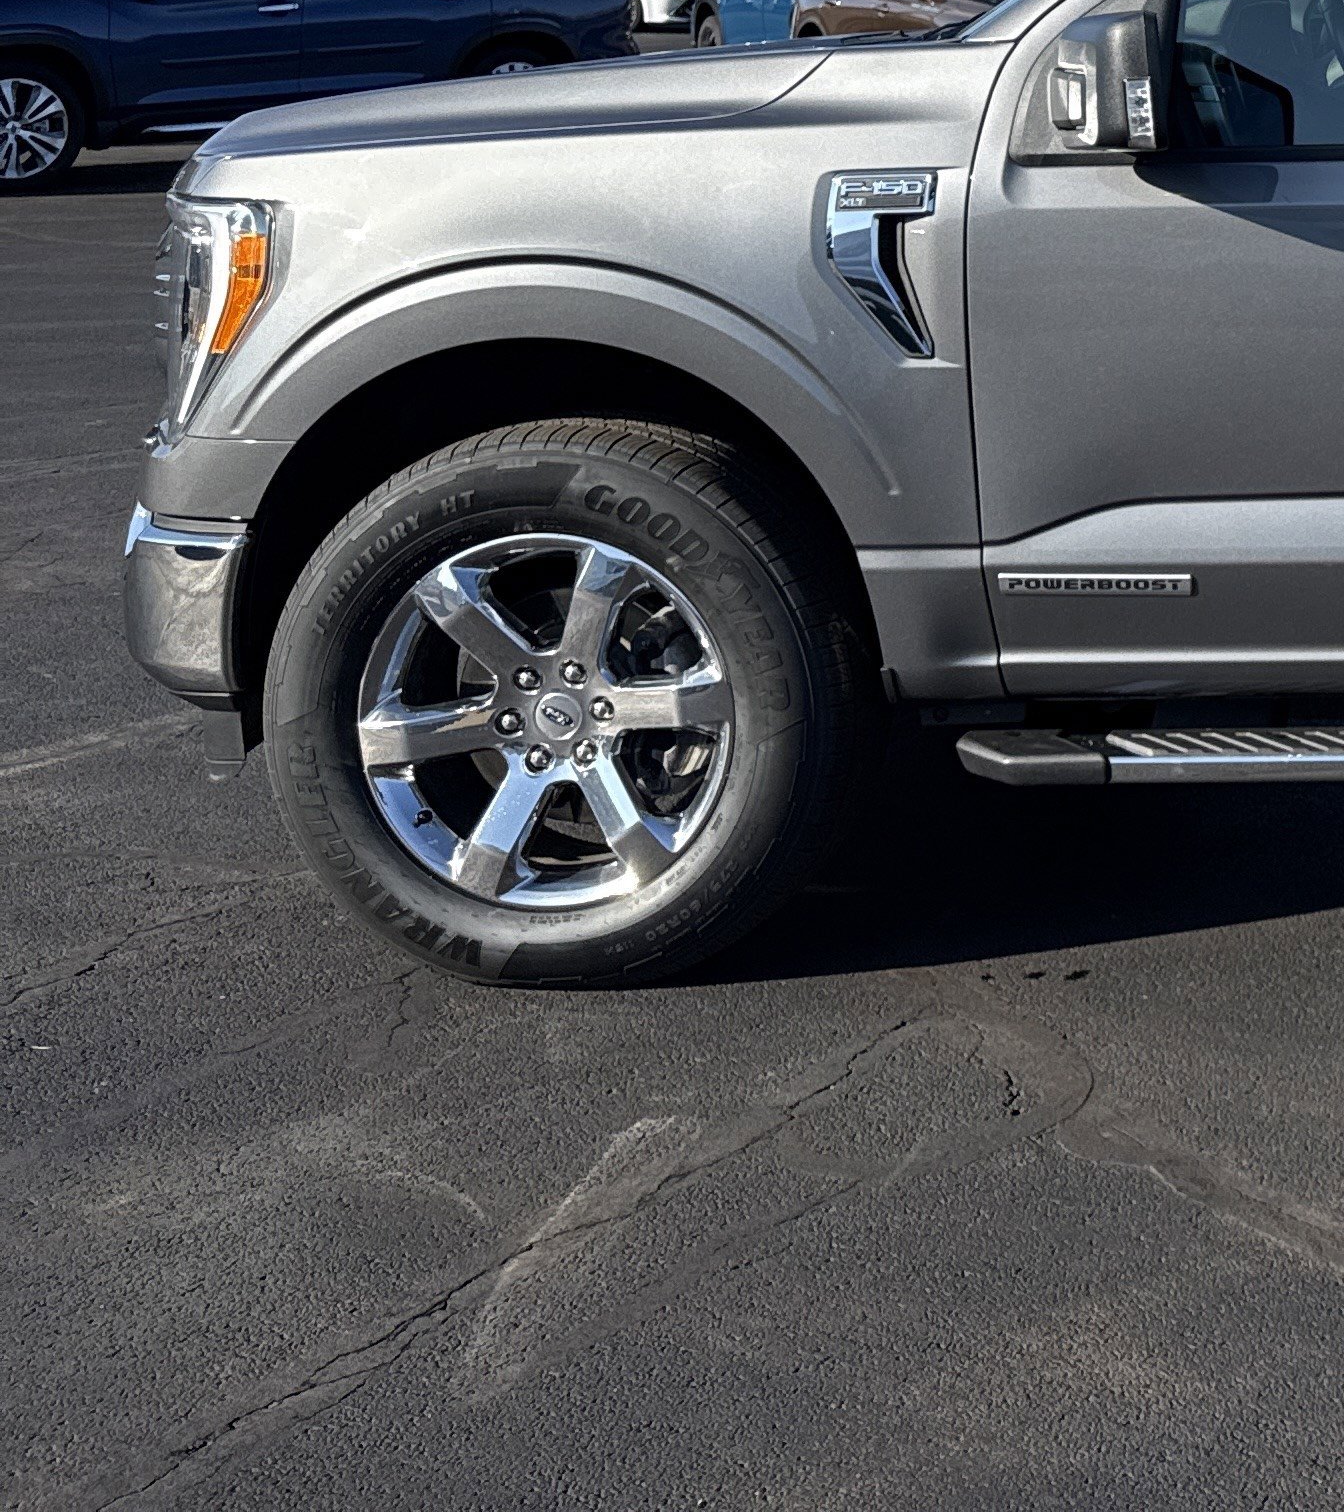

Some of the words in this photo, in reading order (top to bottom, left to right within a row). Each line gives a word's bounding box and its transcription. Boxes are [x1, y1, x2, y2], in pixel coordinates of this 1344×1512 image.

[839, 197, 865, 207] XLT
[840, 180, 923, 196] F-150
[311, 510, 422, 636] TERRITORY
[440, 488, 476, 517] HT
[583, 484, 791, 712] GOODYEAR
[1008, 577, 1183, 590] POWERBOOST
[286, 738, 483, 967] WRANGLER
